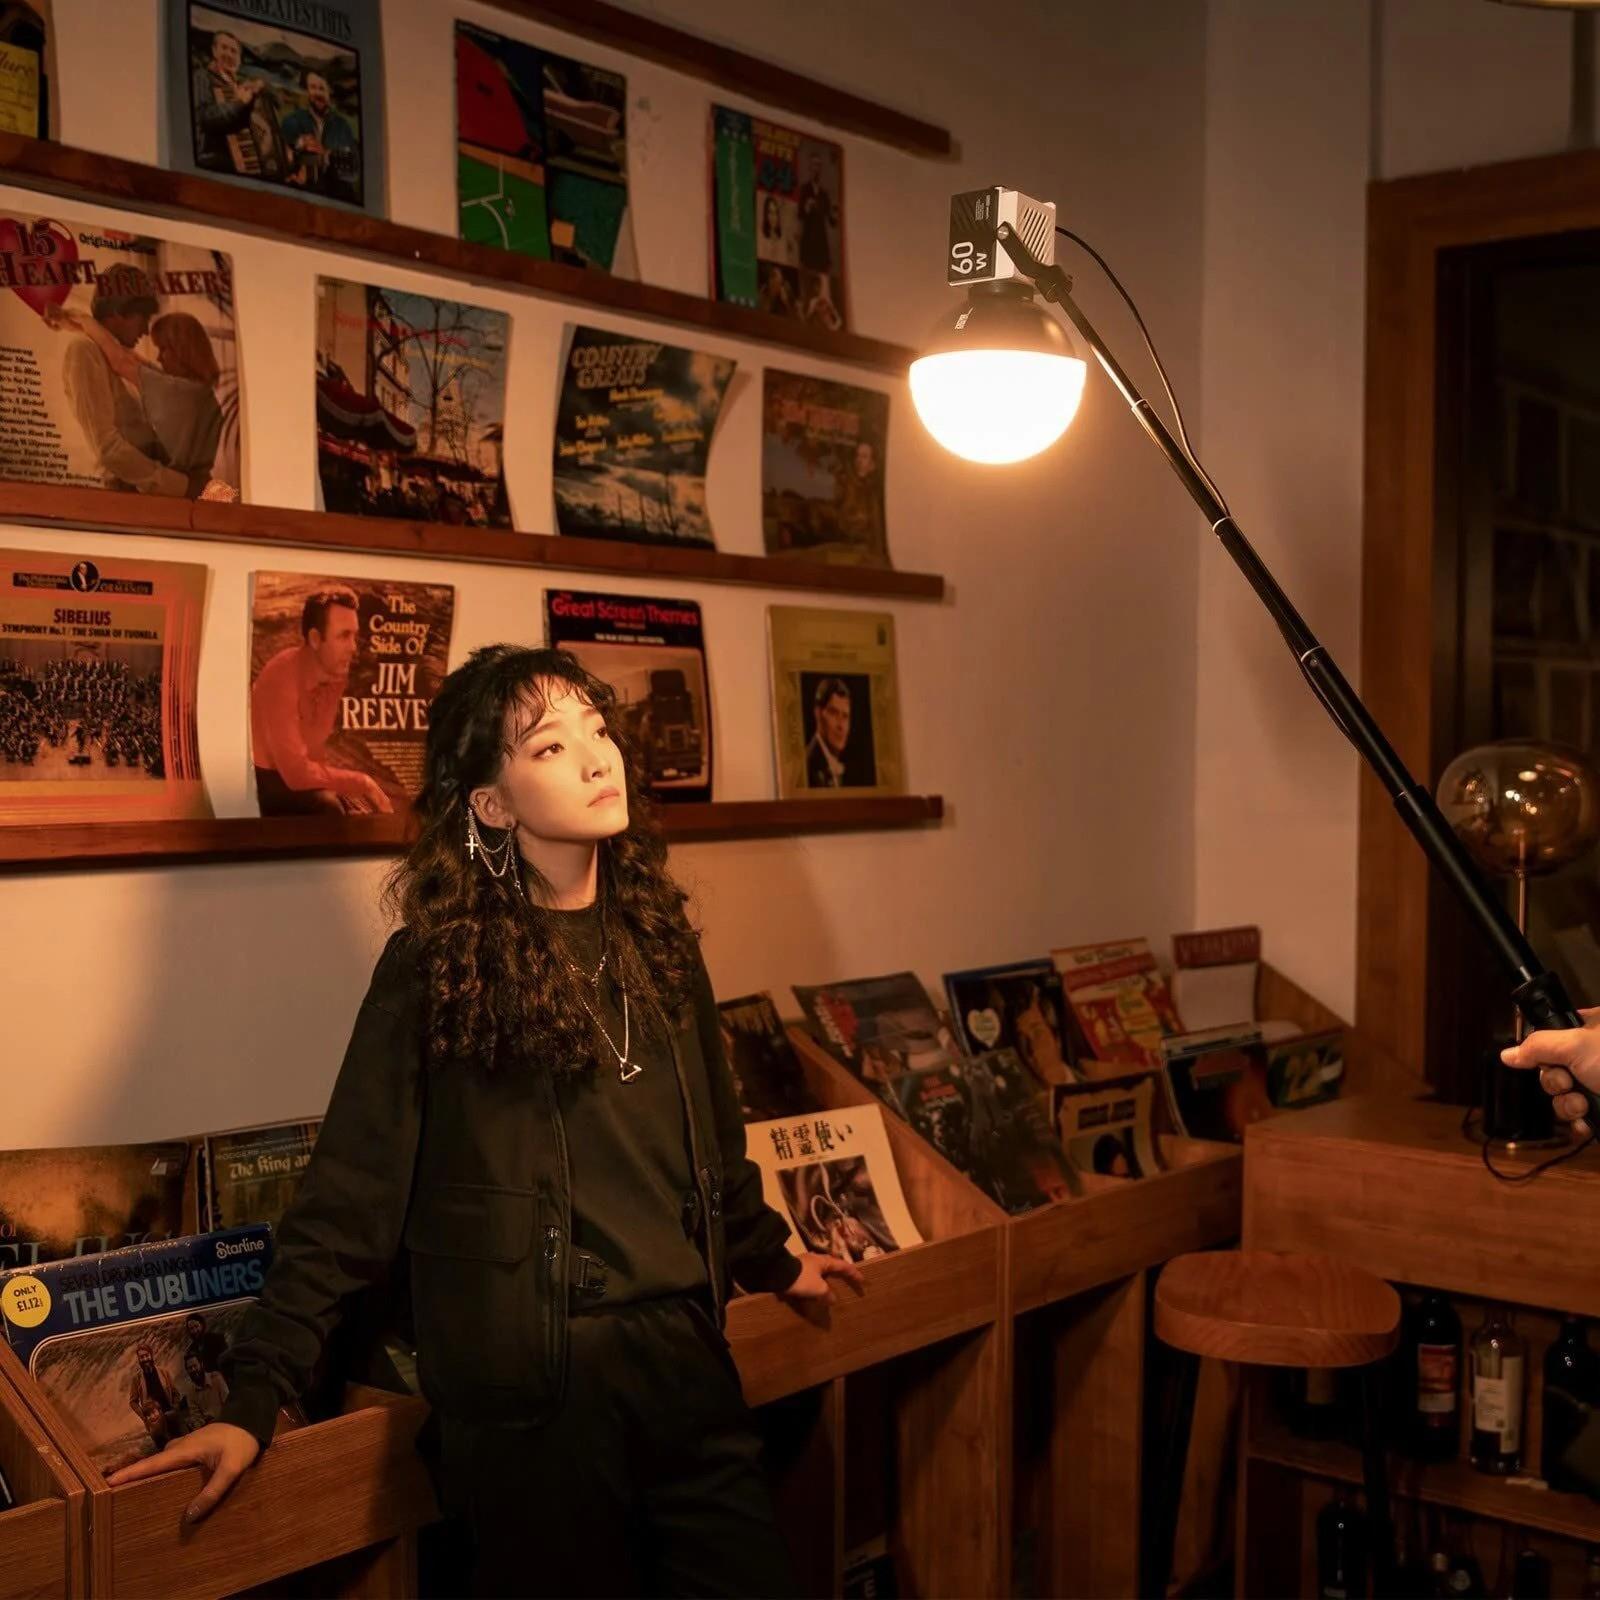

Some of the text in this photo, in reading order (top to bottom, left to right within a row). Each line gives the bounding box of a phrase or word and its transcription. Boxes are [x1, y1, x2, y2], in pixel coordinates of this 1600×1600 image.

[322, 7, 351, 41] HITS
[16, 220, 57, 256] 15
[951, 241, 974, 275] 60
[975, 252, 988, 271] W
[387, 594, 417, 614] The
[552, 598, 595, 619] Great
[597, 599, 646, 622] Screen
[645, 603, 698, 627] Themes
[53, 608, 112, 626] SIBELIUS
[369, 614, 430, 638] Country
[2, 623, 47, 634] SYMPHONY
[72, 627, 87, 636] THE
[88, 627, 111, 637] SWAN
[112, 629, 123, 638] OF
[370, 634, 427, 655] Side Of
[371, 662, 417, 695] JIM
[342, 696, 433, 731] REEVE
[769, 1120, 853, 1161] 精霊使い
[228, 1162, 255, 1179] The
[215, 1237, 266, 1260] Starline
[13, 1284, 37, 1297] ONLY
[63, 1258, 265, 1325] THE DUBLINERS
